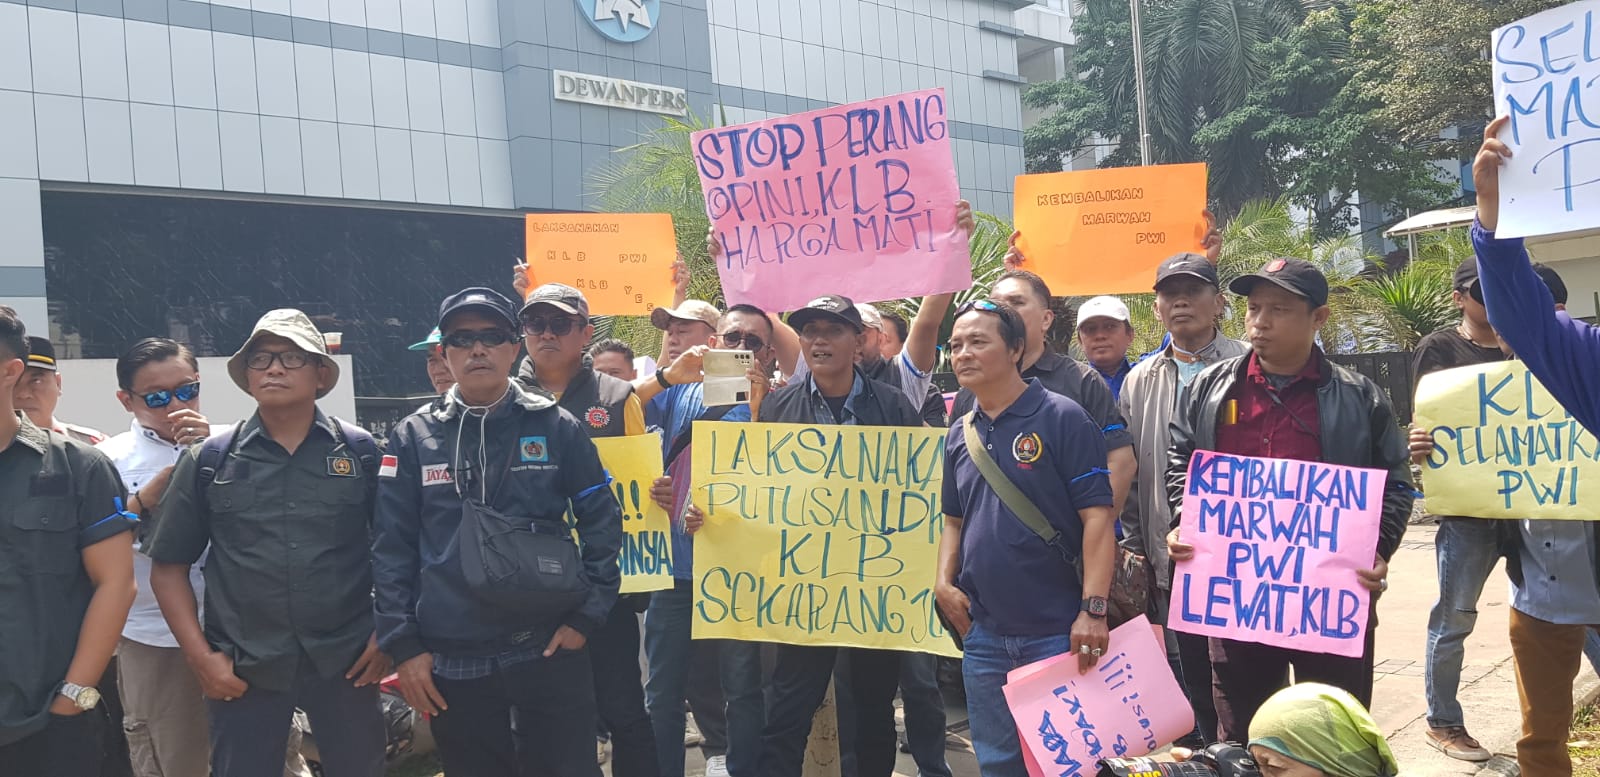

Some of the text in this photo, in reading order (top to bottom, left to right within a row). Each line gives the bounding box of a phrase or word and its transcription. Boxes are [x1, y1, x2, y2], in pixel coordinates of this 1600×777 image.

[559, 74, 686, 110] DEWANPERS
[697, 94, 946, 180] STOP PERANG
[1037, 187, 1144, 206] KEMBALIKAN
[533, 223, 619, 233] LAKSANAKAN
[720, 209, 937, 270] HARGA MATI
[1082, 212, 1150, 225] MARWAH
[1136, 232, 1165, 244] PWI
[619, 254, 647, 263] PWI
[1189, 452, 1368, 511] KEMBALIKAN
[1496, 466, 1578, 509] PWI
[1199, 498, 1340, 552] MARWAH
[779, 529, 904, 582] KLB
[1226, 542, 1305, 583] PWI
[696, 567, 906, 634] SEKARANG
